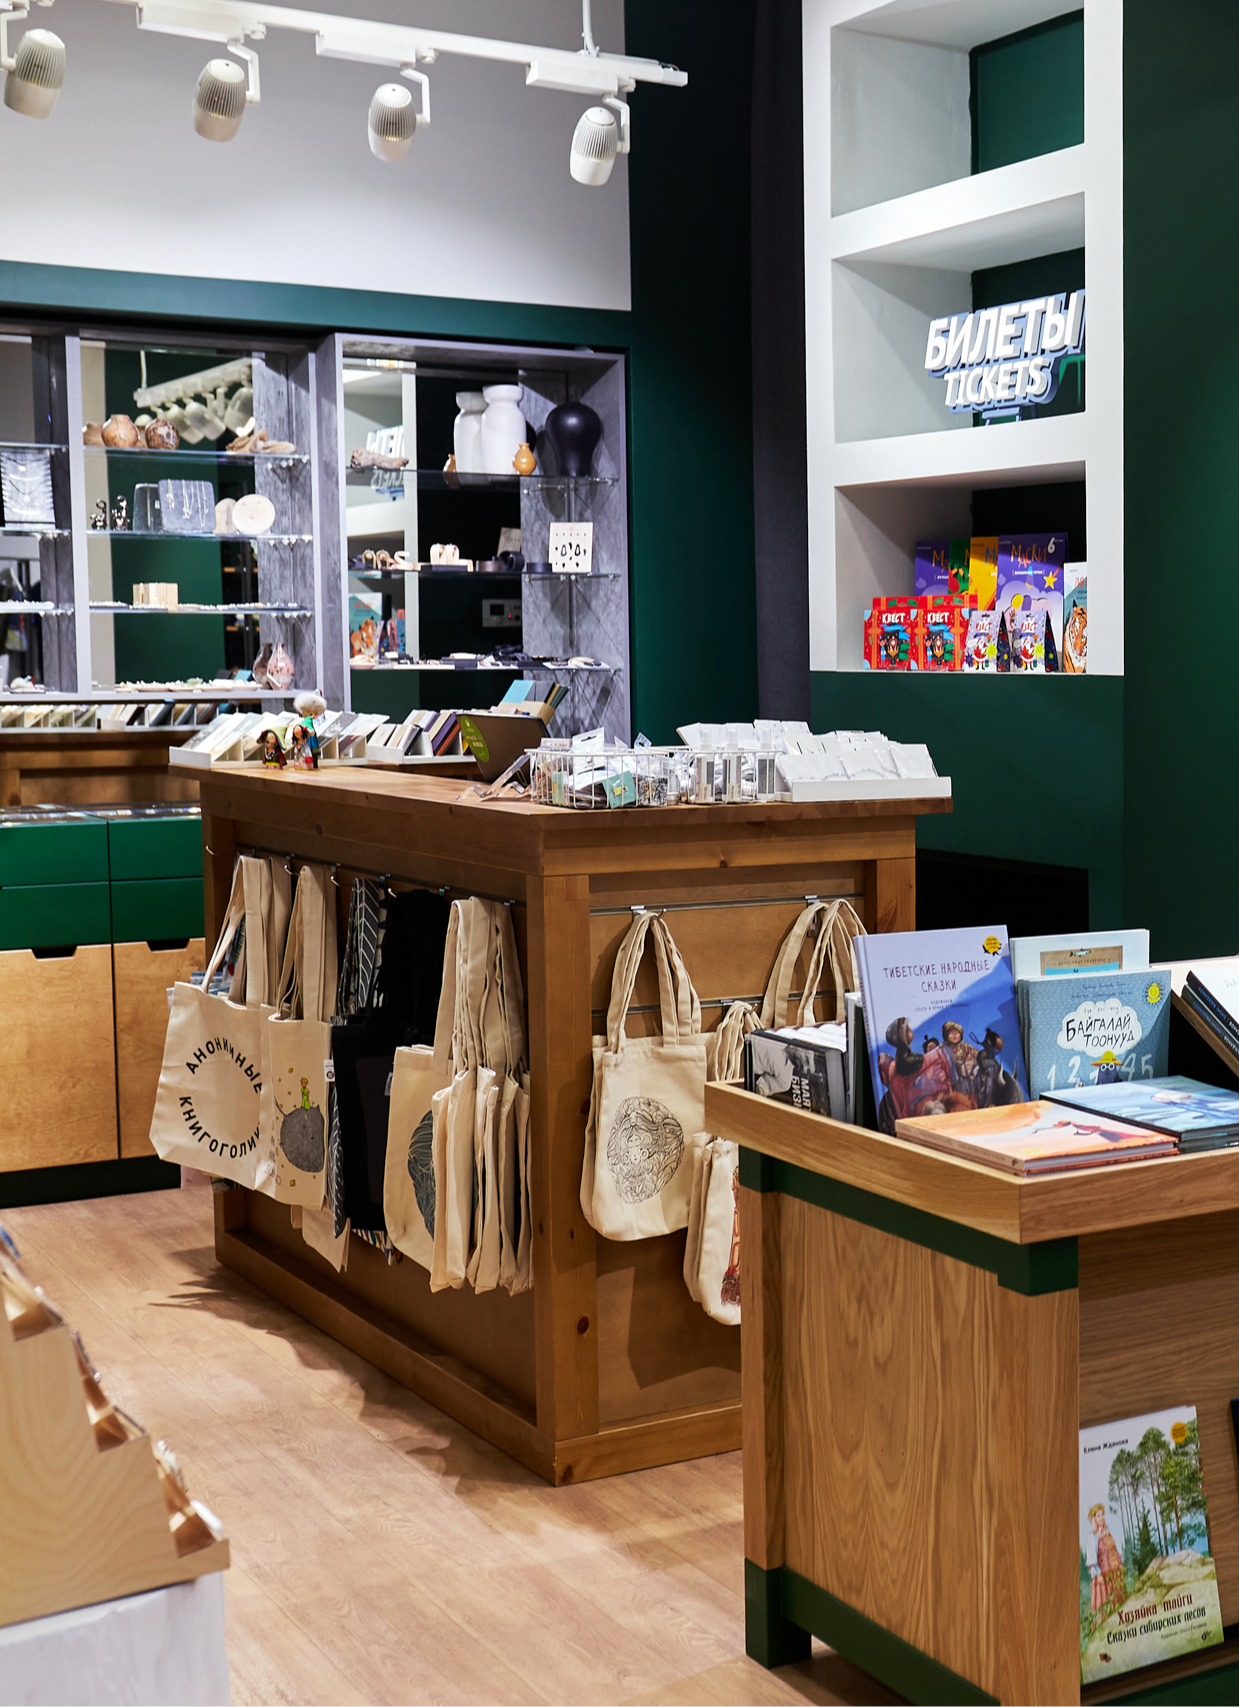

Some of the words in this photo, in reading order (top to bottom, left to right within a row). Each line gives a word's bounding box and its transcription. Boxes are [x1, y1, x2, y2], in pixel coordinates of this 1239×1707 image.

[924, 291, 1085, 370] БИЛЕТЫ
[943, 356, 1050, 407] TICKETS
[1047, 537, 1055, 554] 6
[882, 612, 905, 624] КВЕСТ
[927, 612, 949, 624] КВЕСТ
[883, 963, 937, 979] ТИБЕТСКИЕ
[941, 959, 990, 974] НАРОДНЫЕ
[921, 979, 957, 993] СКАЗКИ
[1083, 1030, 1135, 1049] ТООНУУД
[1118, 1603, 1157, 1625] Хозяйка
[1163, 1593, 1193, 1612] тайги
[1107, 1627, 1137, 1645] Сказки
[1139, 1614, 1182, 1635] сибирских
[1184, 1606, 1206, 1621] лесов
